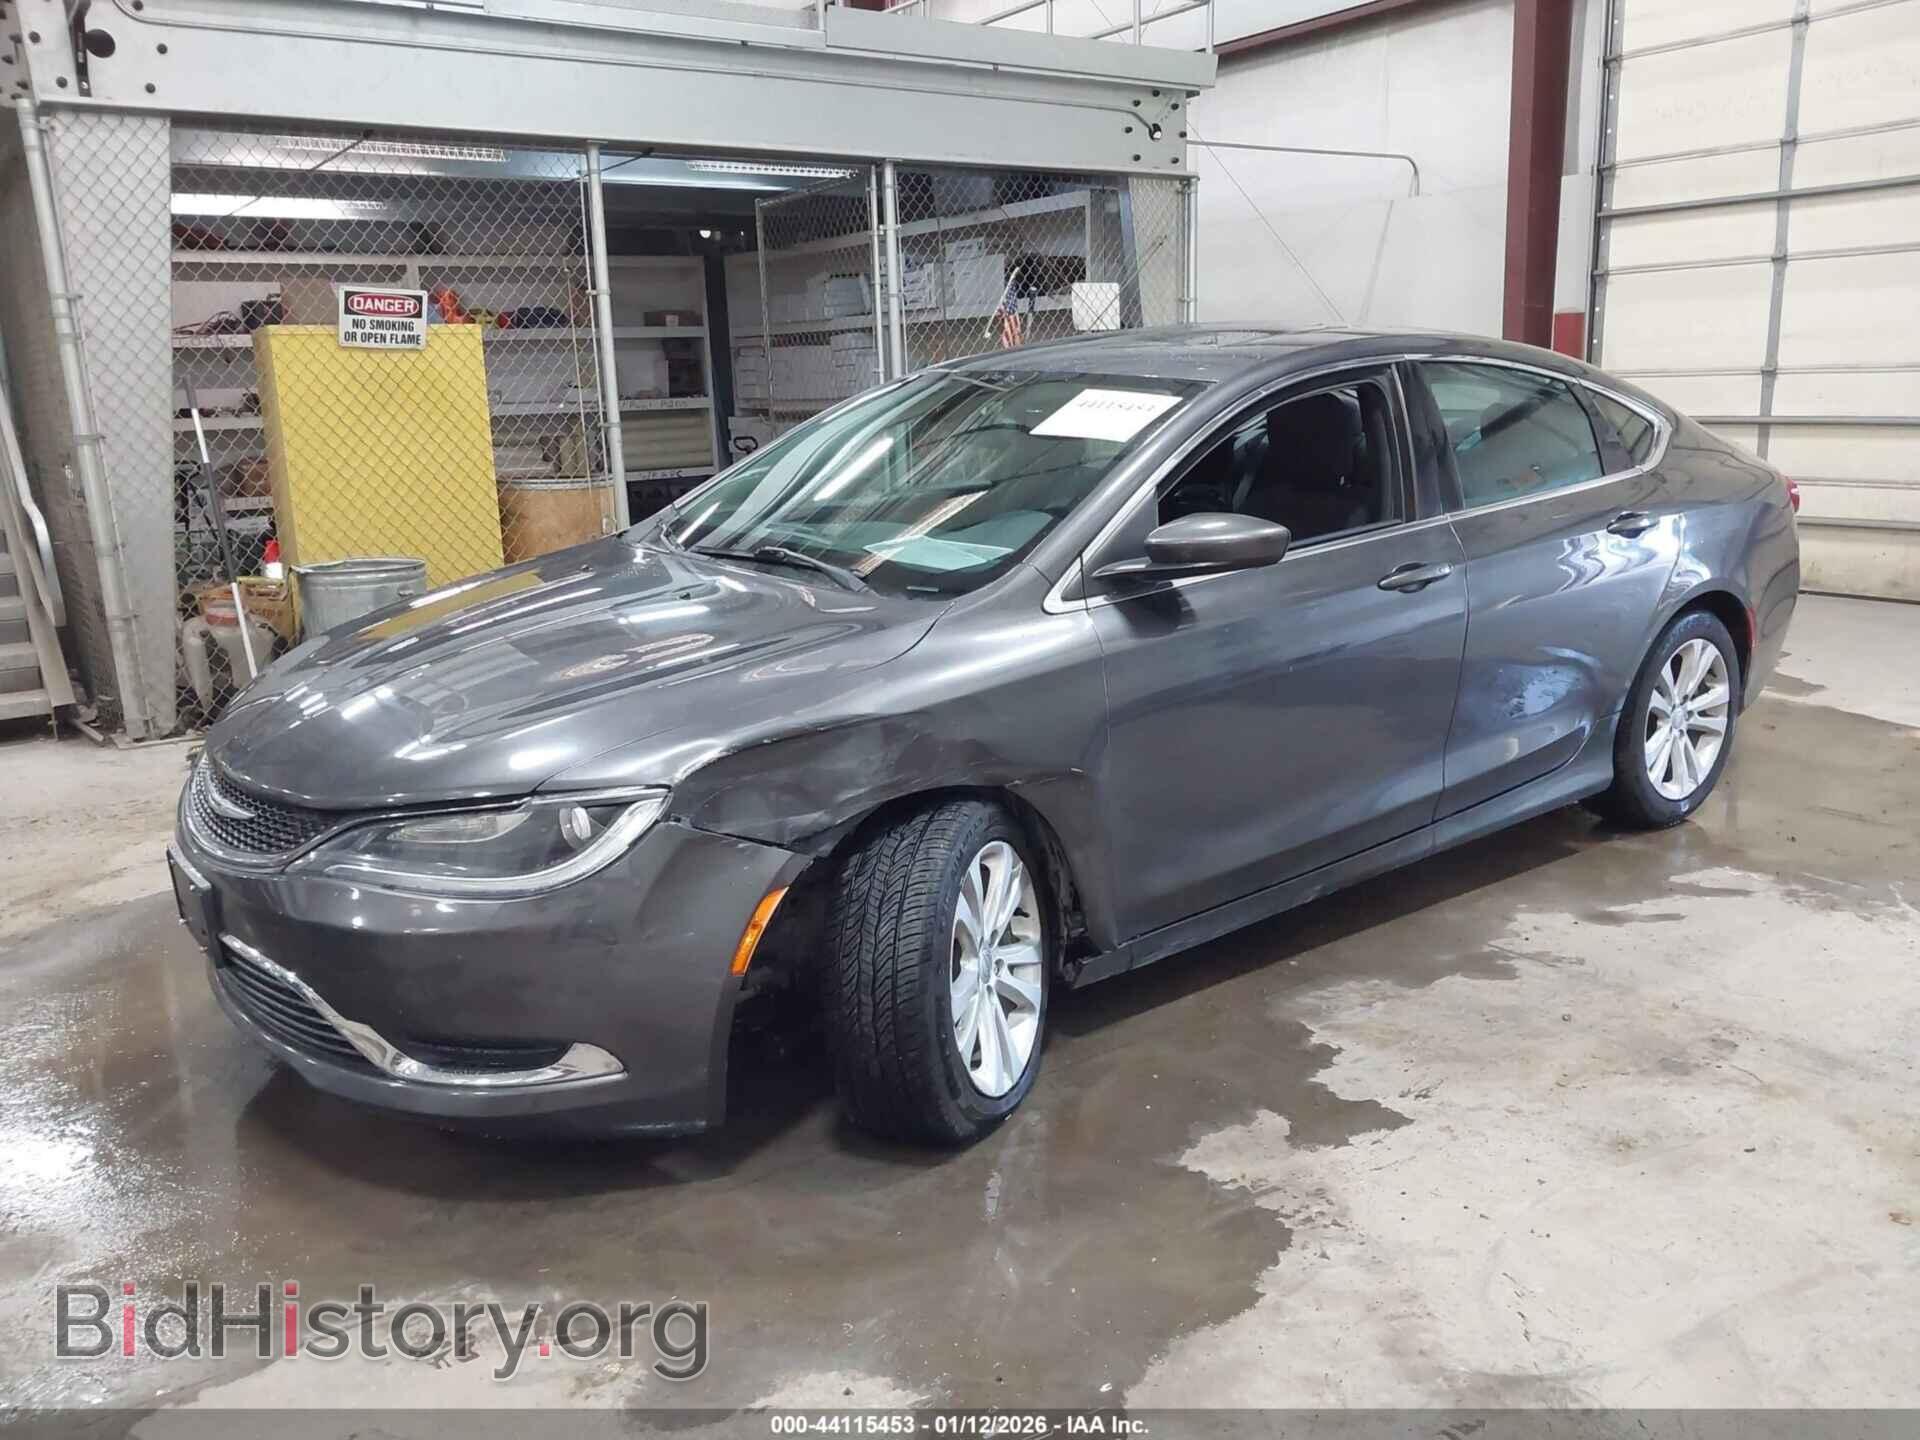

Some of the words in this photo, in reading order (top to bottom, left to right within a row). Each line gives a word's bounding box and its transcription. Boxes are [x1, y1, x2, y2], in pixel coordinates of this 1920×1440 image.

[353, 297, 414, 312] DANGER
[352, 319, 366, 330] NO
[369, 319, 415, 332] SMOKING
[344, 332, 357, 342] OR
[360, 332, 387, 344] OPEN
[390, 334, 421, 345] FLAME
